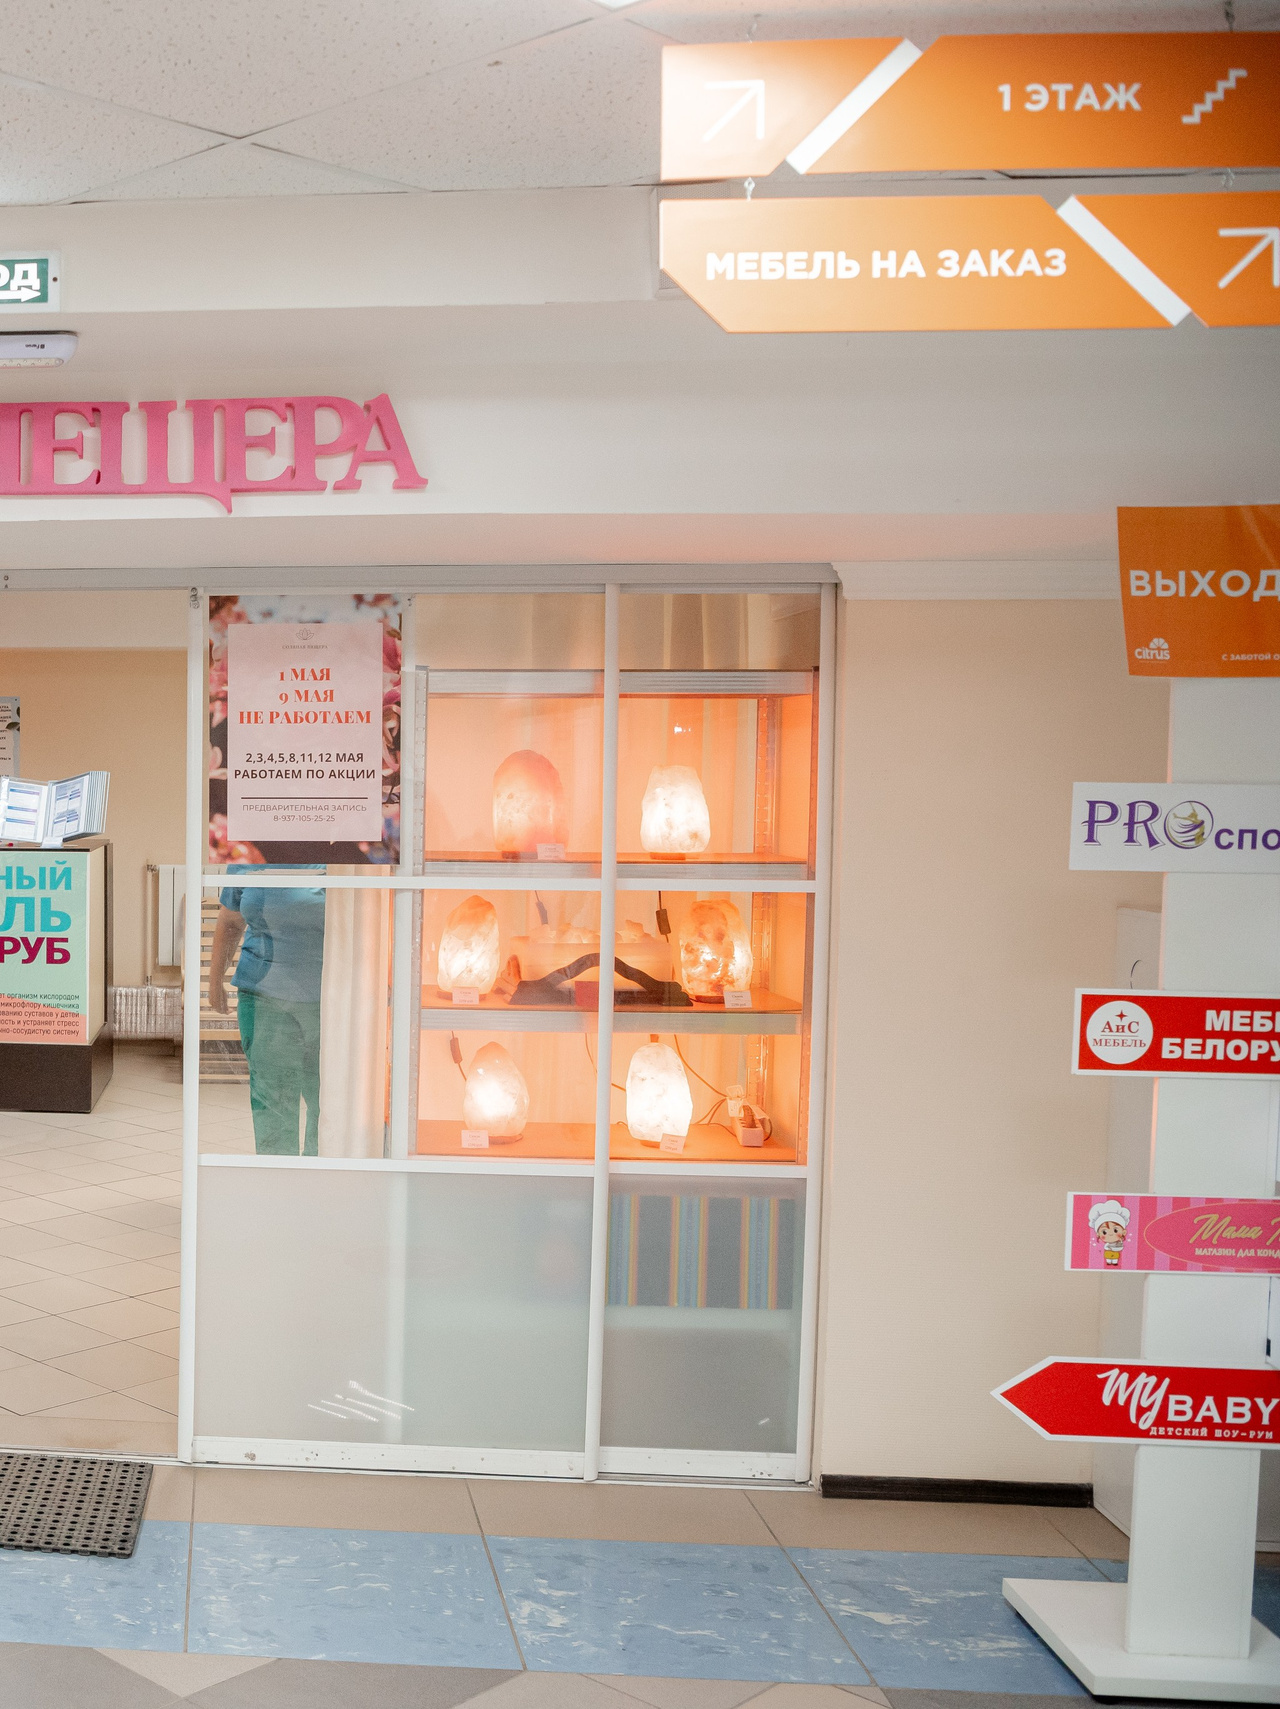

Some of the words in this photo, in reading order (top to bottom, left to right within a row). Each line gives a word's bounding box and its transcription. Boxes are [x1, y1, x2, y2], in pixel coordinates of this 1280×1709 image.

[998, 84, 1012, 112] 1
[1024, 82, 1142, 112] ЭТАЖ
[706, 250, 860, 280] МЕБЕЛЬ
[870, 250, 926, 280] НА
[936, 248, 1066, 278] ЗАКАЗ
[1130, 570, 1280, 602] ВЫХОД
[1230, 652, 1272, 660] ЗАБОТОЙ
[278, 670, 286, 682] 1
[290, 668, 332, 682] МАЯ
[278, 692, 289, 706] 9
[294, 689, 335, 703] МАЯ
[238, 711, 264, 724] НЕ
[269, 710, 372, 724] РАБОТАЕМ
[245, 752, 332, 764] 2,3,4,5,8,11,12
[335, 752, 364, 763] МАЯ
[234, 769, 302, 779] РАБОТАЕМ
[306, 769, 325, 779] ПО
[328, 769, 376, 782] АКЦИИ
[242, 804, 330, 813] ПРЕДВАРИТЕЛЬНАЯ
[330, 804, 367, 812] ЗАПИСЬ
[273, 814, 336, 822] 8-937-105-25-25
[7, 992, 38, 1000] организм
[39, 994, 80, 1002] кислородом
[0, 1001, 41, 1010] микрофлору
[42, 1002, 80, 1010] кишечника
[24, 1010, 54, 1018] суставов
[60, 1010, 80, 1018] детей
[22, 1019, 55, 1027] устраняет
[1100, 1020, 1140, 1034] АиС
[52, 1028, 80, 1036] систему
[1092, 1038, 1146, 1048] МЕБЕЛЬ
[1188, 1214, 1264, 1245] Мама
[1194, 1248, 1236, 1256] МАГАЗИН
[1236, 1248, 1255, 1258] ДЛЯ
[1166, 1394, 1280, 1425] BABY
[1150, 1426, 1208, 1437] ДЕТСКИЙ
[1214, 1429, 1274, 1440] ШОУ-РУМ
